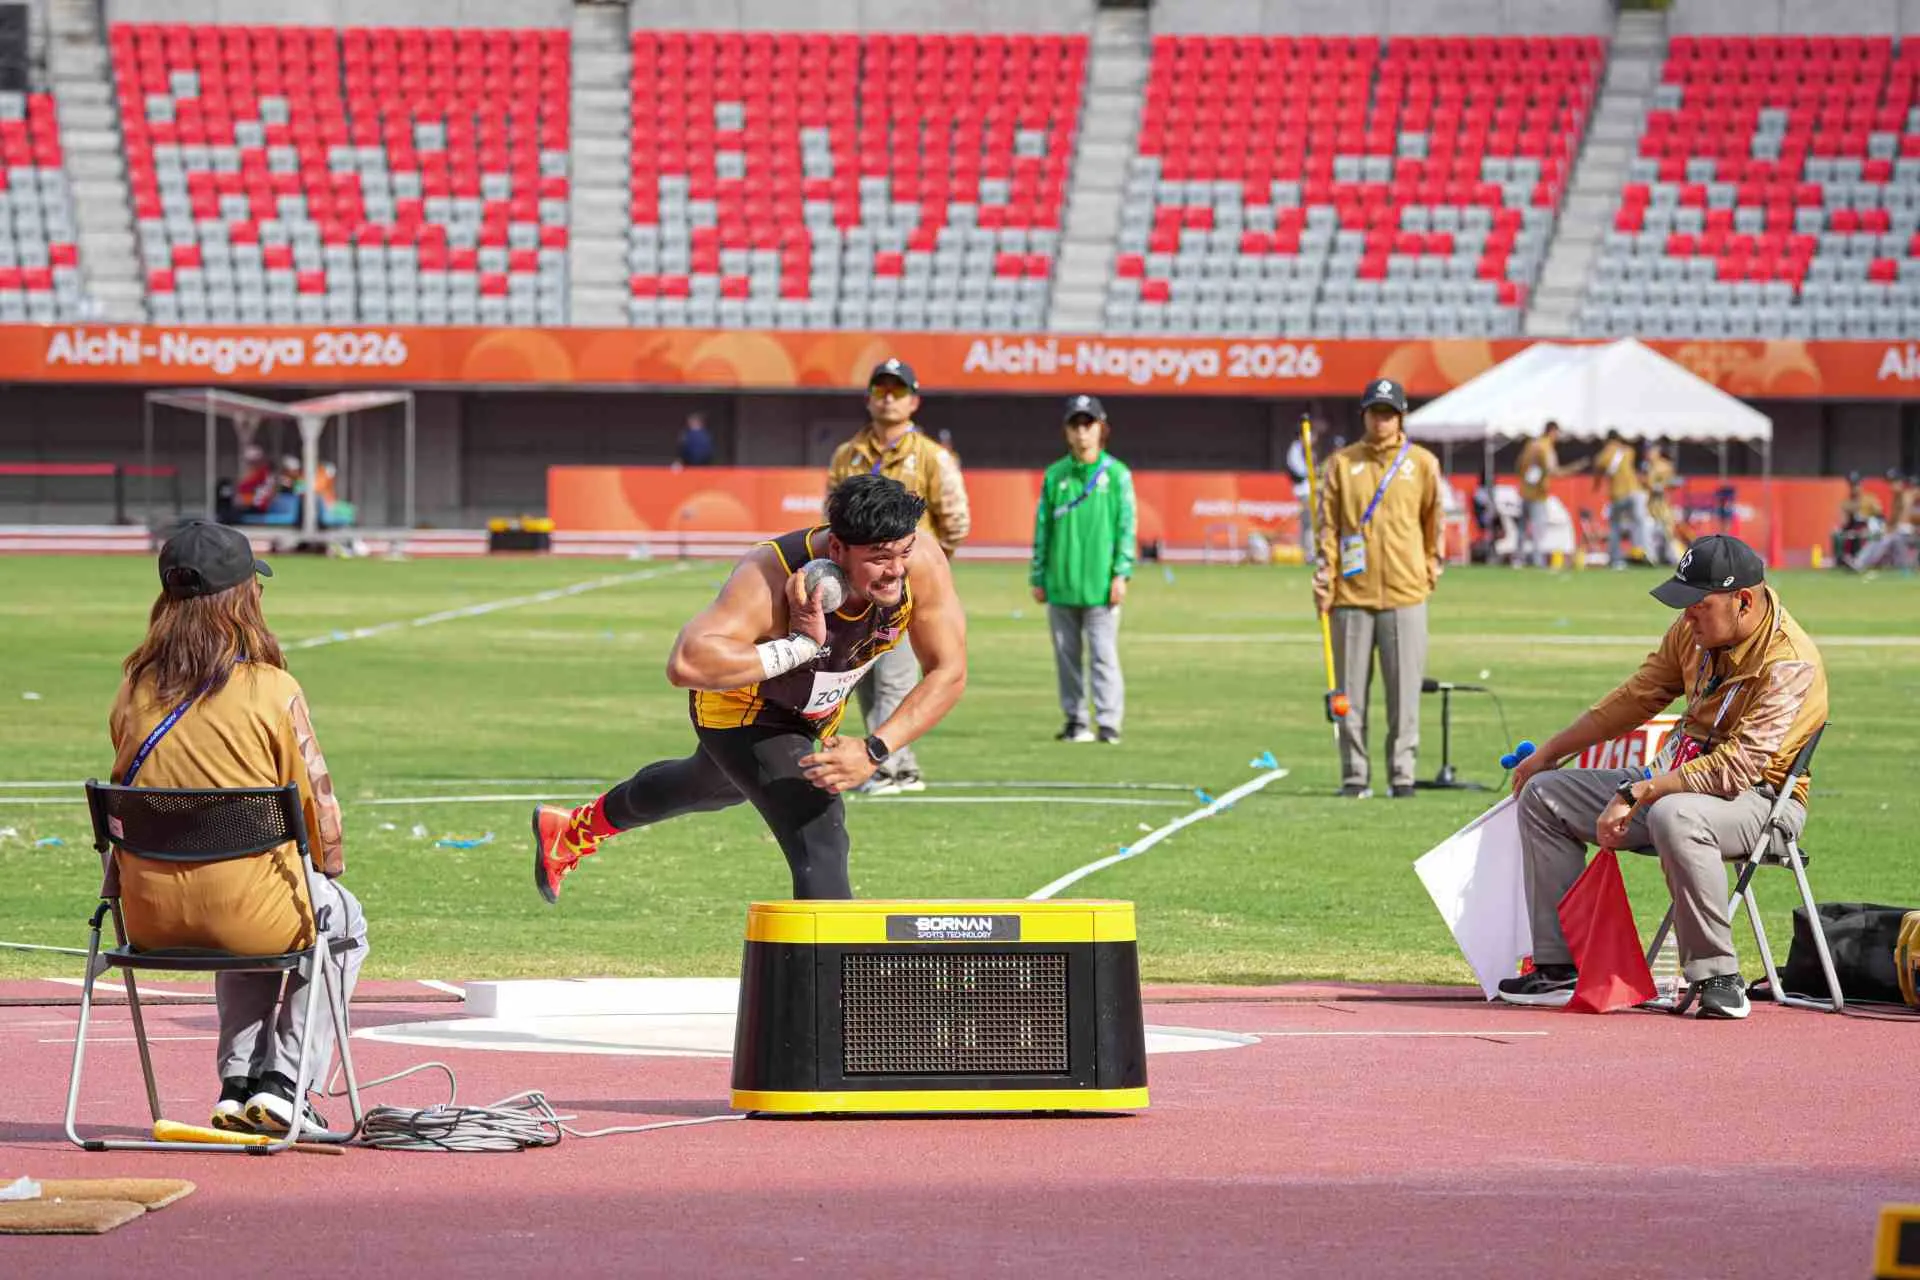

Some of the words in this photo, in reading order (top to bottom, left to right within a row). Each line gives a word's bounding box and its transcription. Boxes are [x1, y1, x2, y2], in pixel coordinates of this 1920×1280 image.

[47, 329, 304, 374] Aichi-Nagoya
[313, 332, 408, 368] 2026
[963, 338, 1221, 384] Aichi-Nagoya
[1227, 343, 1323, 378] 2026
[1877, 341, 1920, 381] Ai
[915, 917, 992, 931] BORNAN
